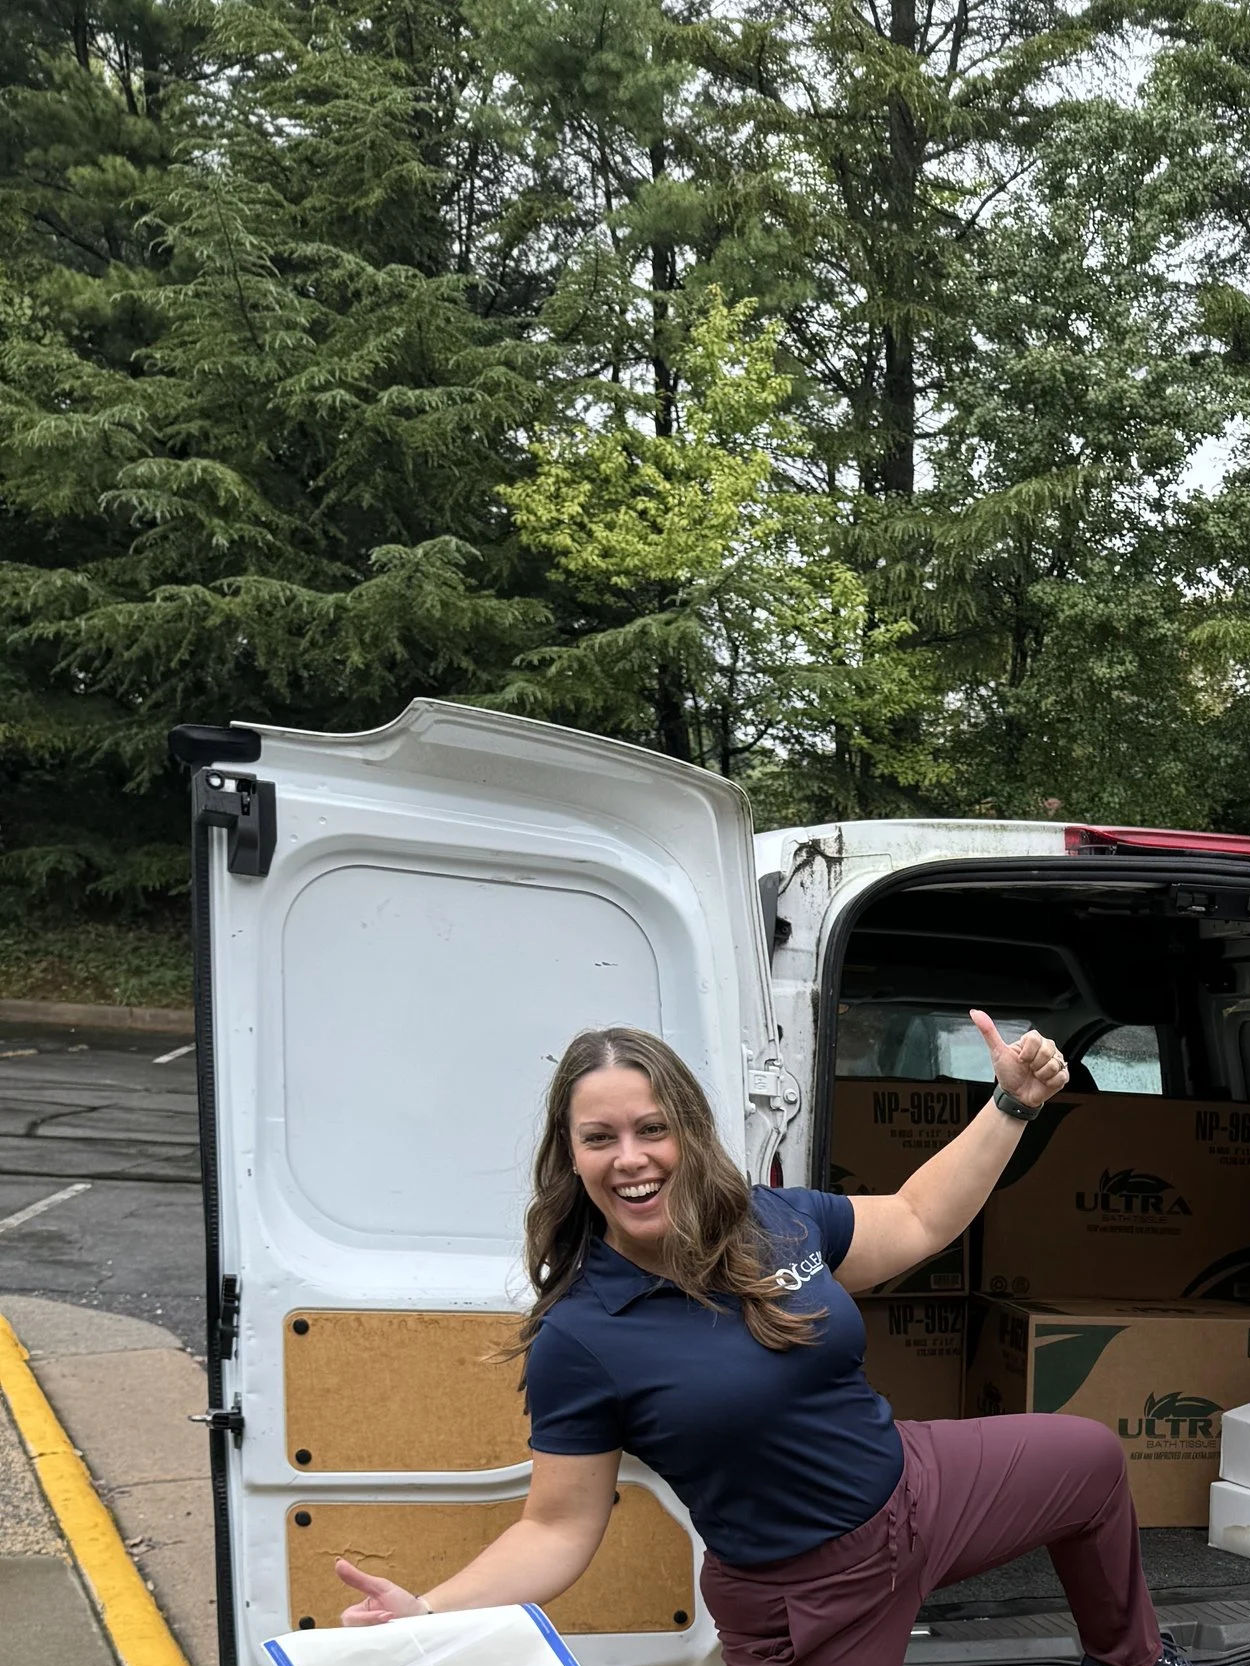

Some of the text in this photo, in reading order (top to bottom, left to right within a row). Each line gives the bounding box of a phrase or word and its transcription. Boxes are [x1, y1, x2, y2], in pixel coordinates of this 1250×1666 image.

[873, 1091, 960, 1125] NP-962U
[1075, 1191, 1193, 1215] ULTRA
[1118, 1418, 1222, 1439] ULTR
[1147, 1440, 1216, 1448] BATH TISSUE
